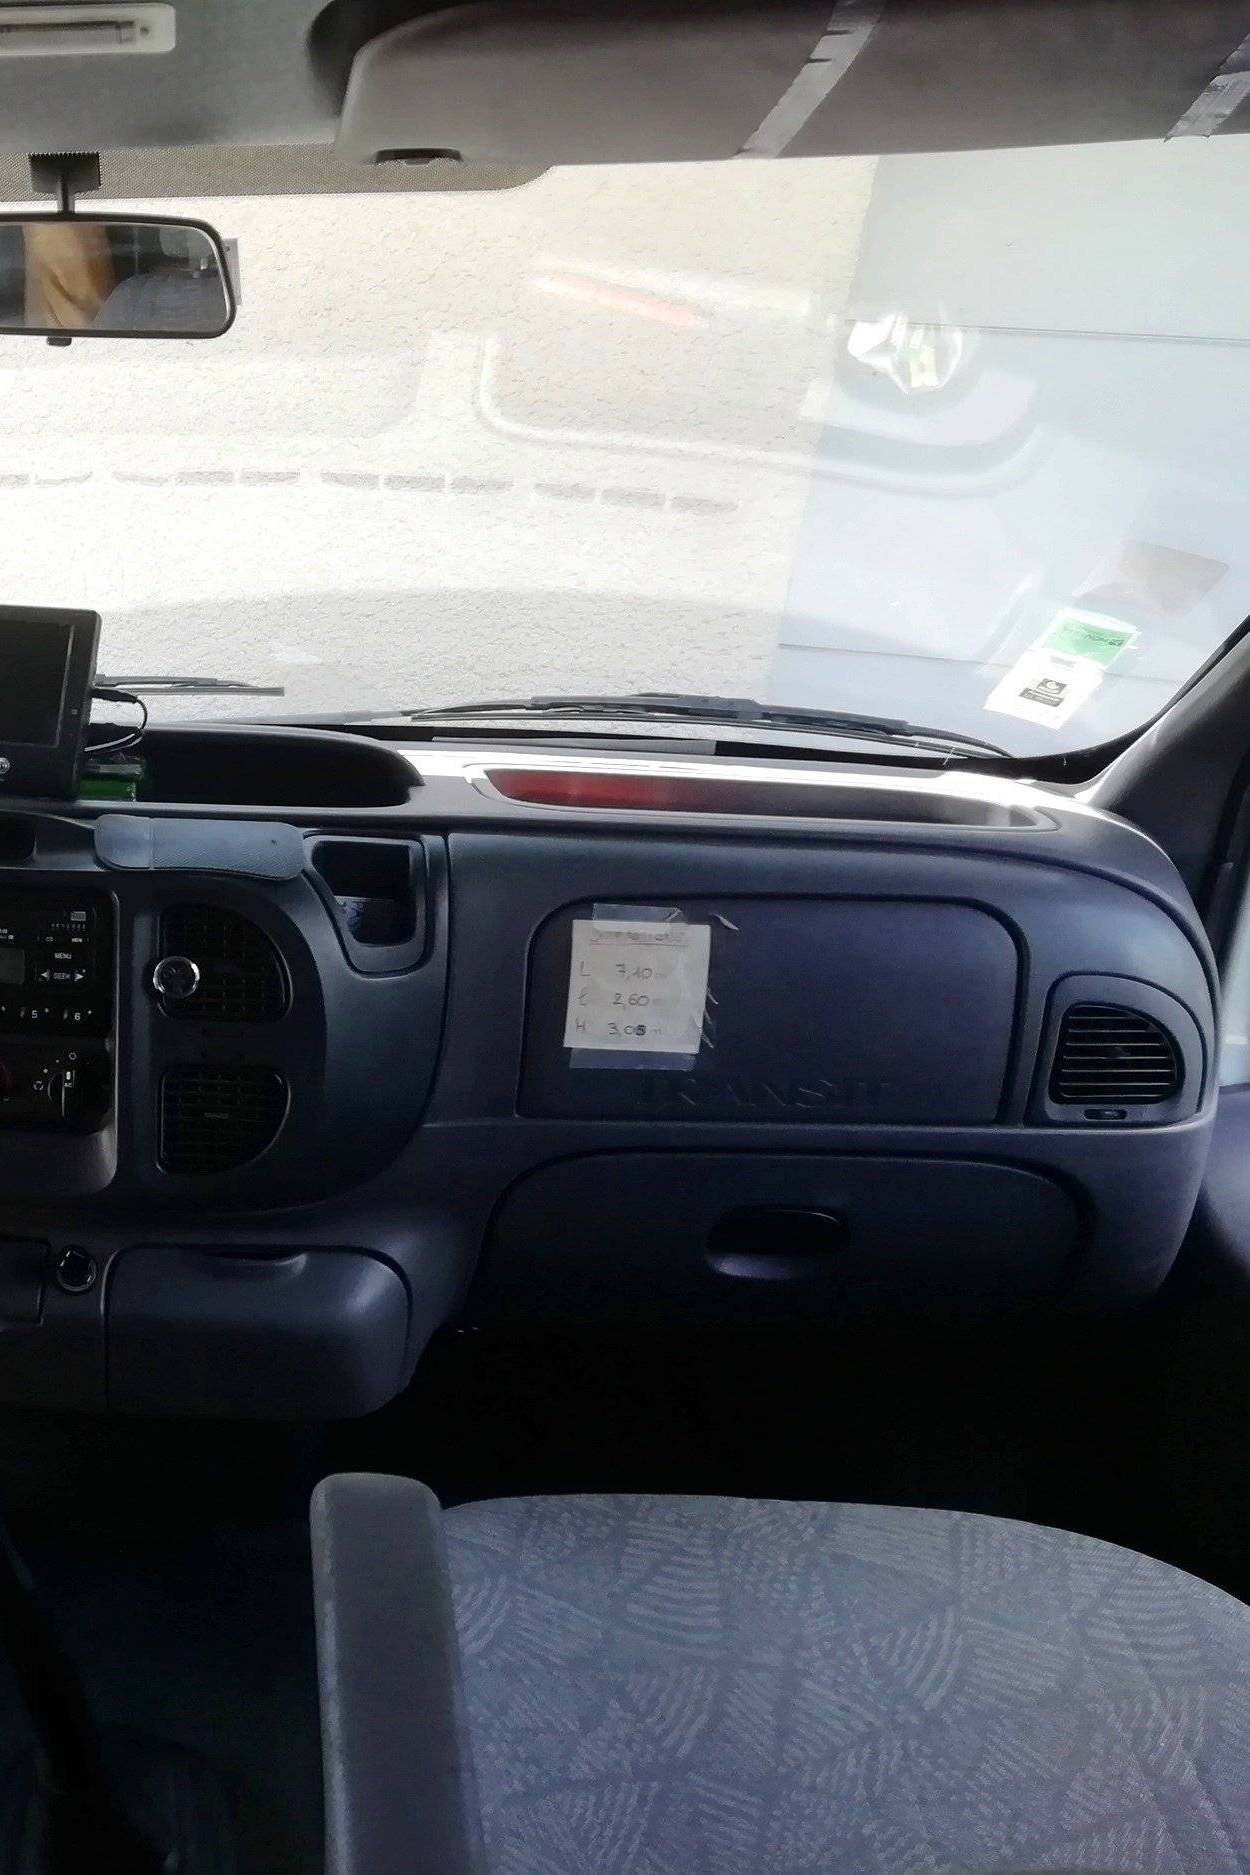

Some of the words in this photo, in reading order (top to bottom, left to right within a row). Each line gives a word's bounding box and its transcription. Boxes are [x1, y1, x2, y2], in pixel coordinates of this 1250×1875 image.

[580, 960, 591, 977] L
[612, 992, 650, 1011] 2,60
[31, 1010, 38, 1019] 5
[74, 1012, 81, 1020] 6
[637, 1076, 891, 1110] TRANSIT
